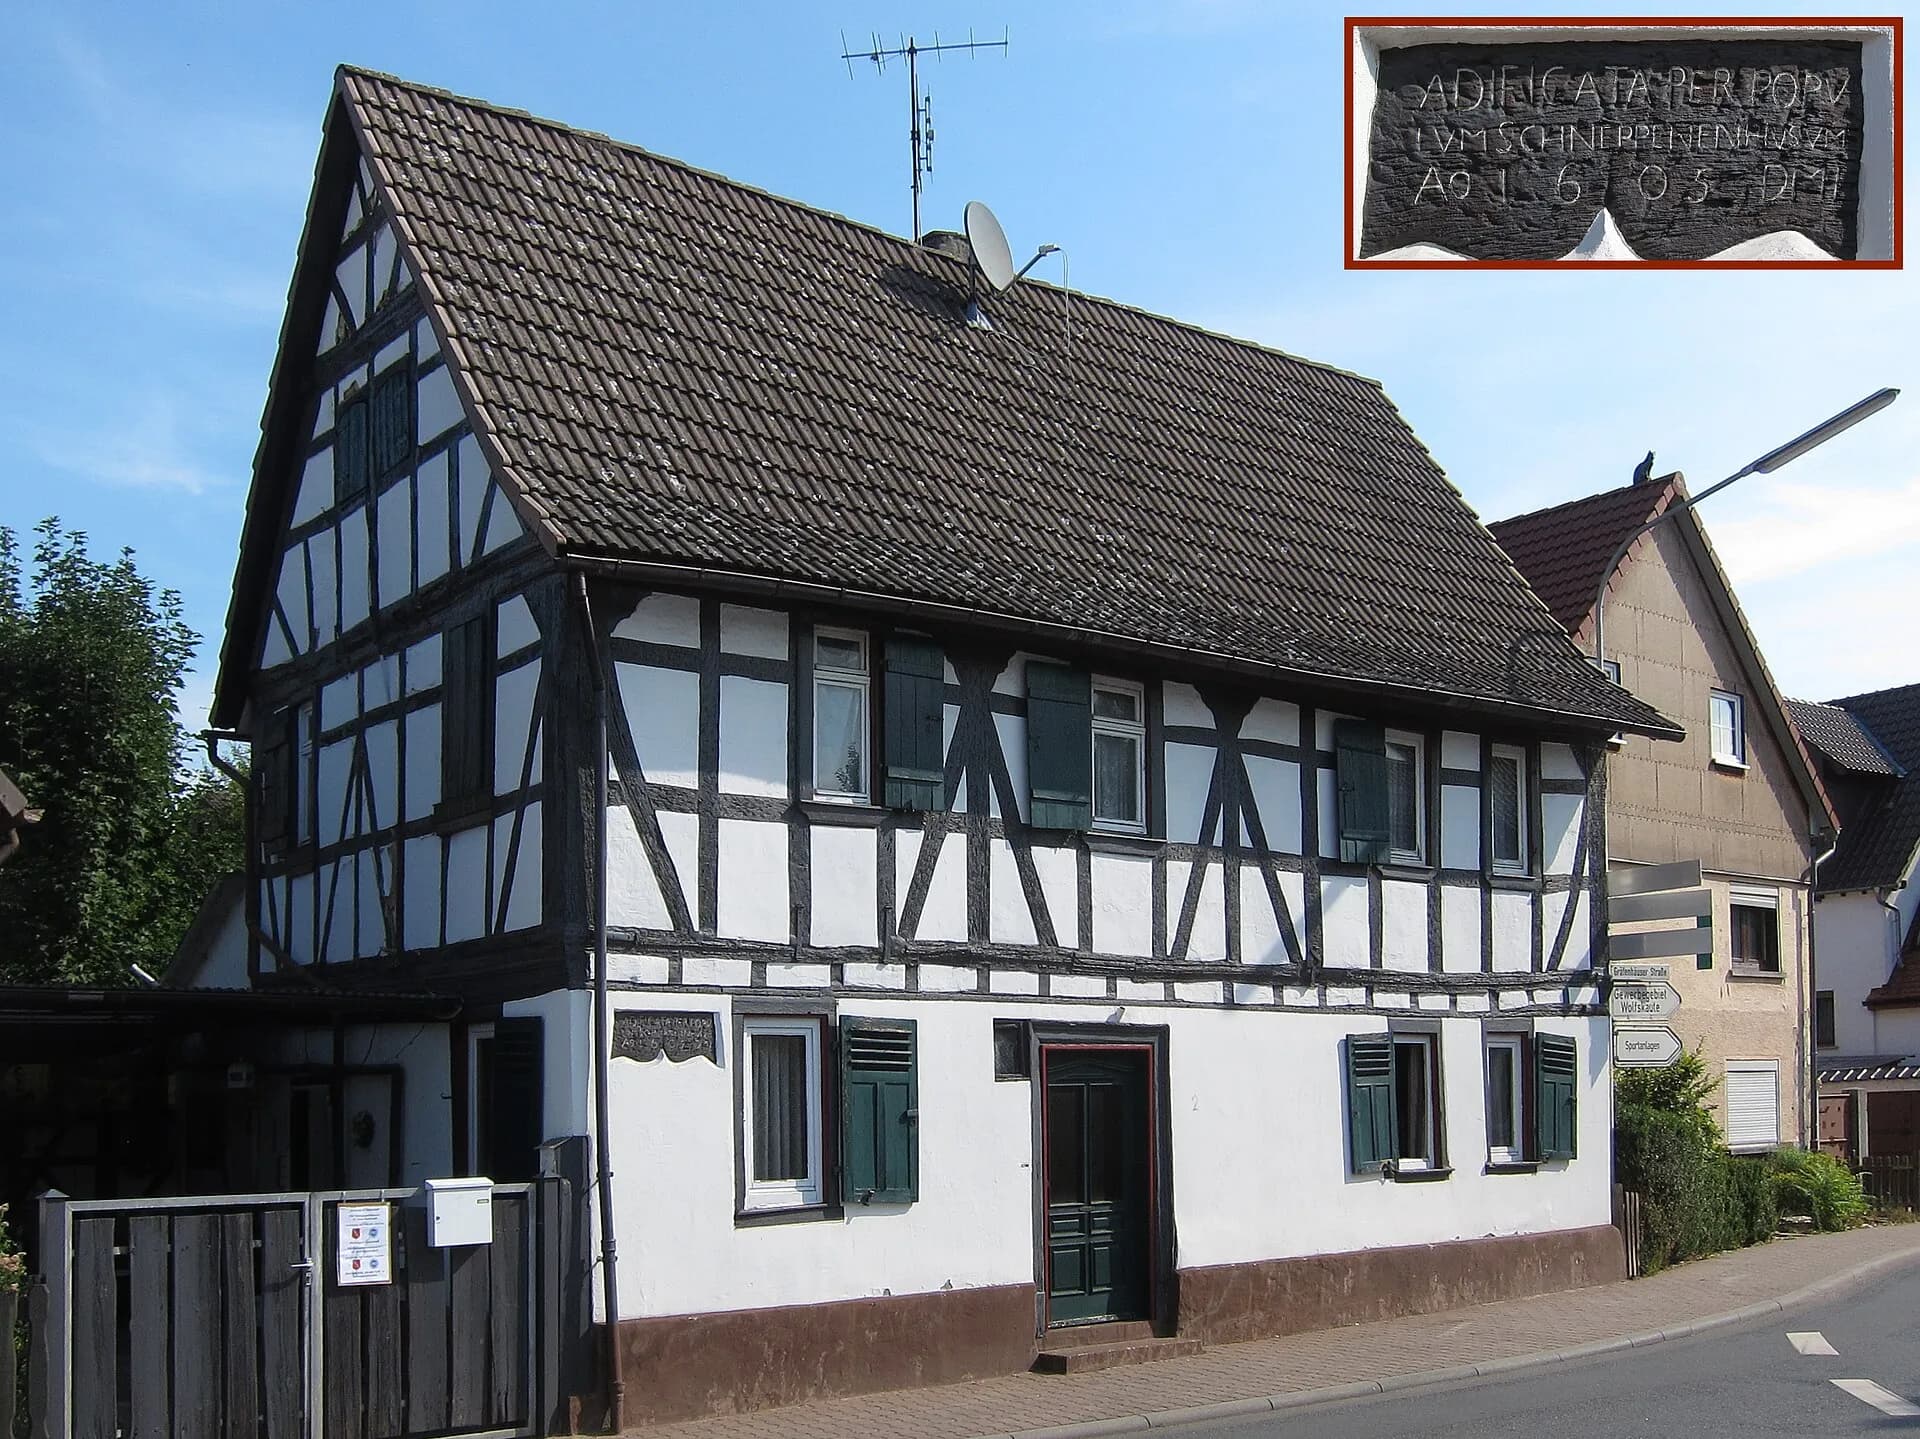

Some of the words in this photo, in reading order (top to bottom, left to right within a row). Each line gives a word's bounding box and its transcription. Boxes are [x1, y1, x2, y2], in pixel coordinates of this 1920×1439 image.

[1668, 65, 1741, 111] PER
[1650, 966, 1667, 977] Straße
[1614, 988, 1667, 1002] Gewerbegebiet
[1621, 1001, 1660, 1013] Wolfskaute
[1625, 1040, 1660, 1052] Sportanlagen
[1192, 1094, 1199, 1111] 2
